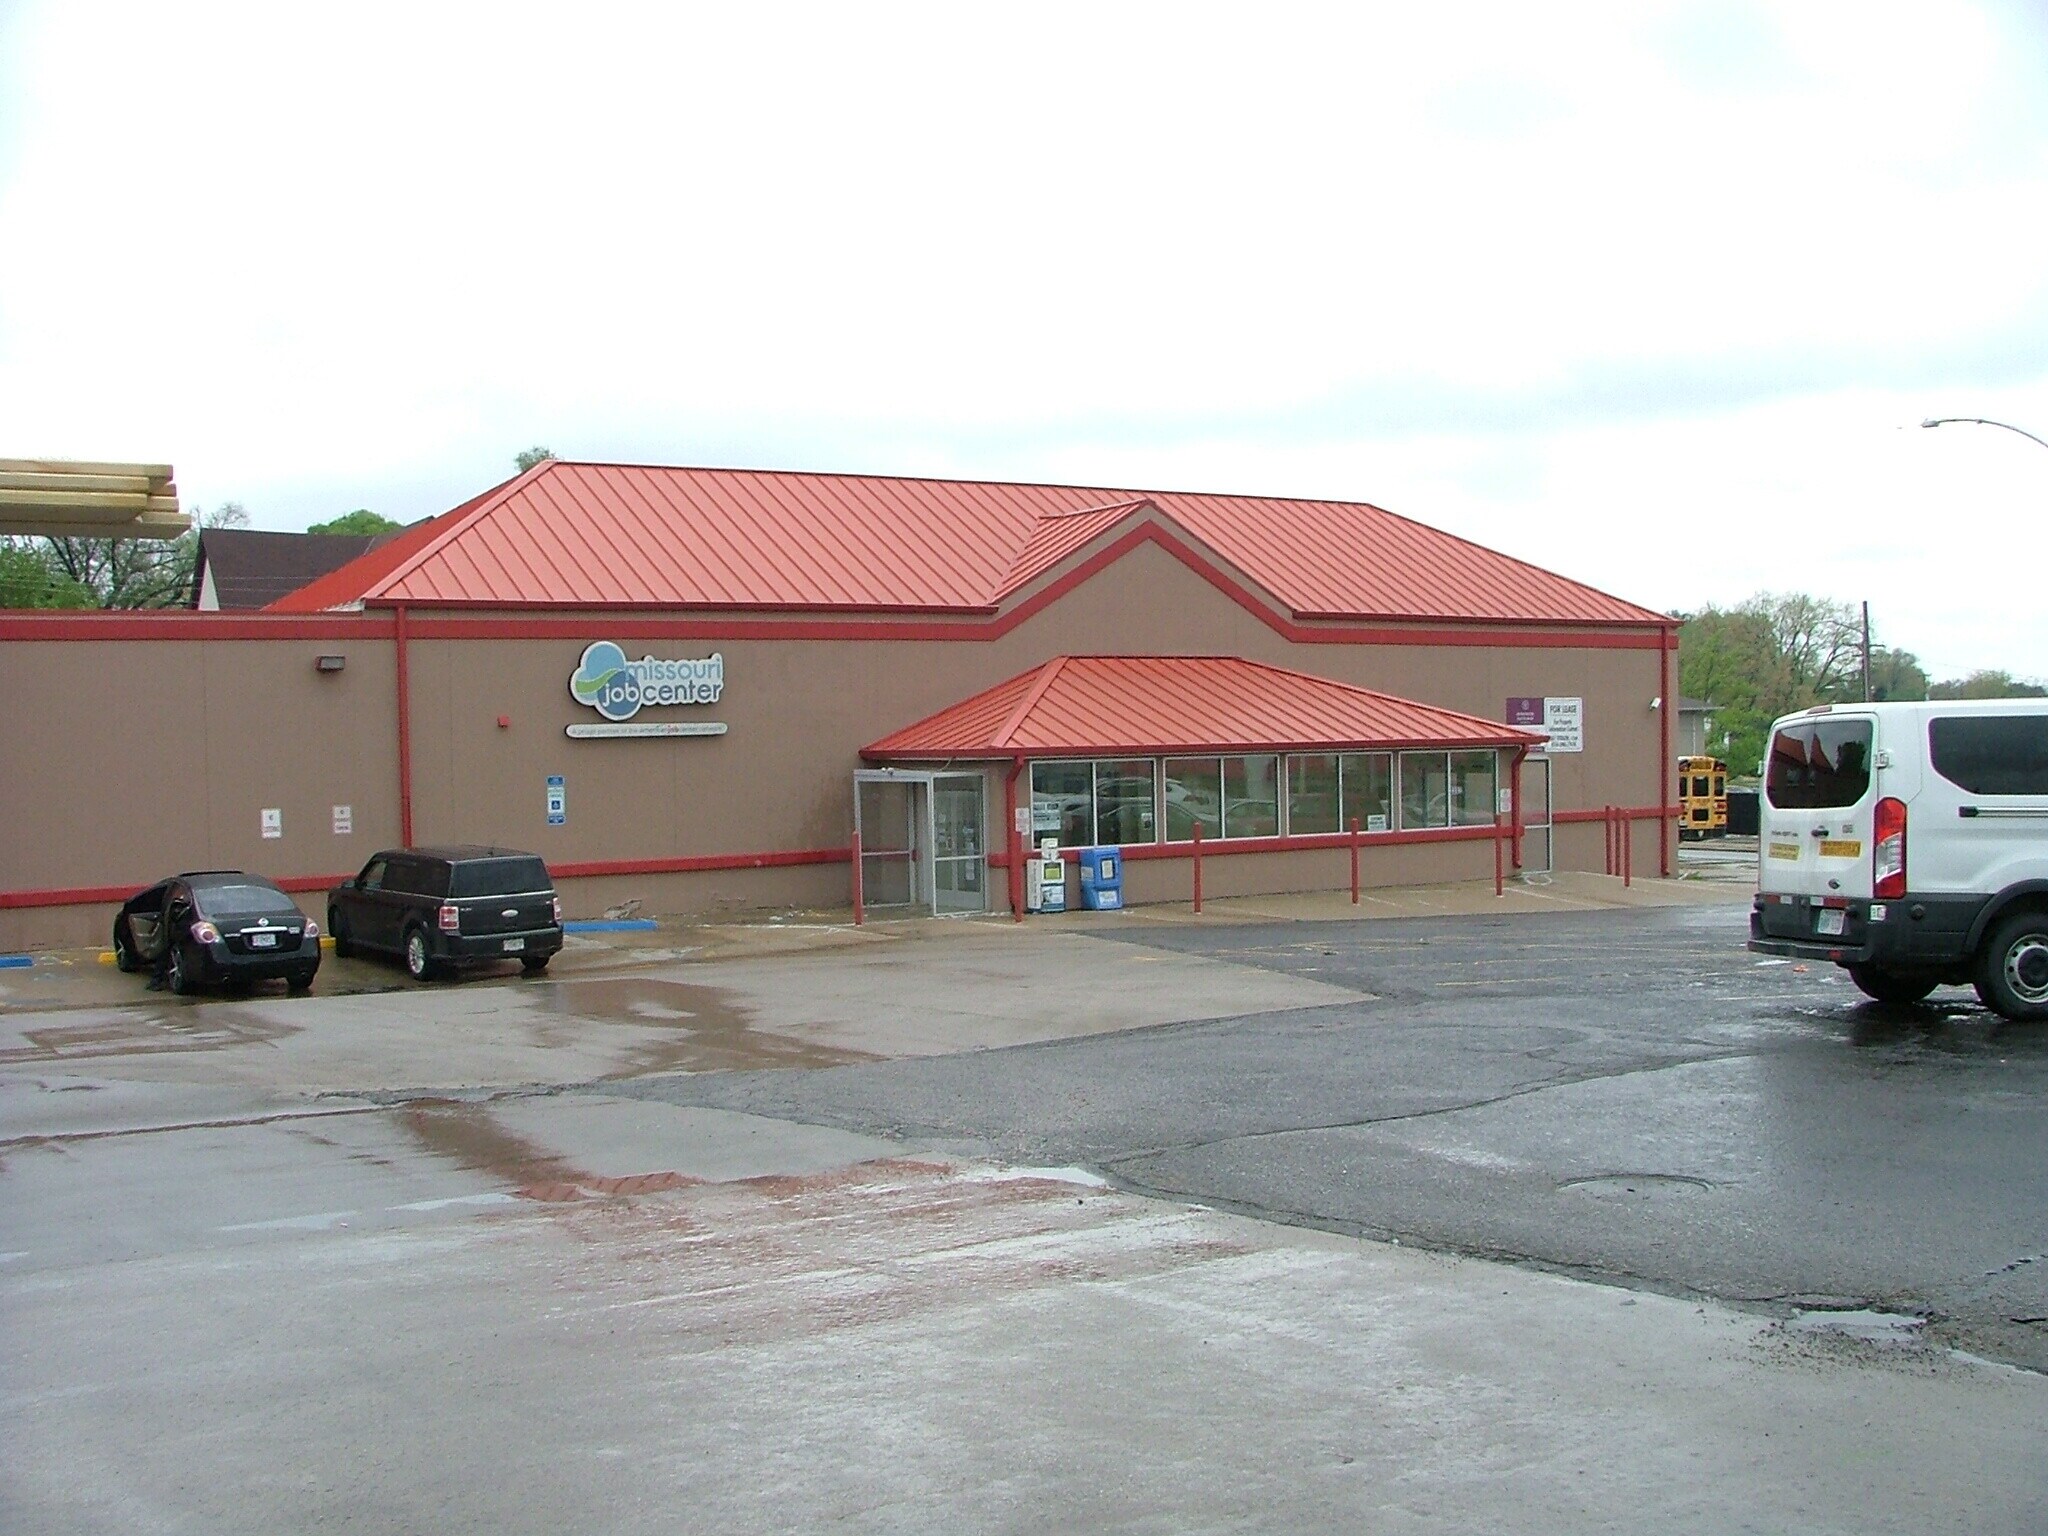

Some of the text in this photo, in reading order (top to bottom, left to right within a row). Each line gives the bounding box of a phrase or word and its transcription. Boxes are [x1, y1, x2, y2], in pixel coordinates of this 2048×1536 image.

[625, 658, 721, 681] missouri
[602, 680, 722, 707] job center
[1549, 704, 1577, 714] FOR LEASE
